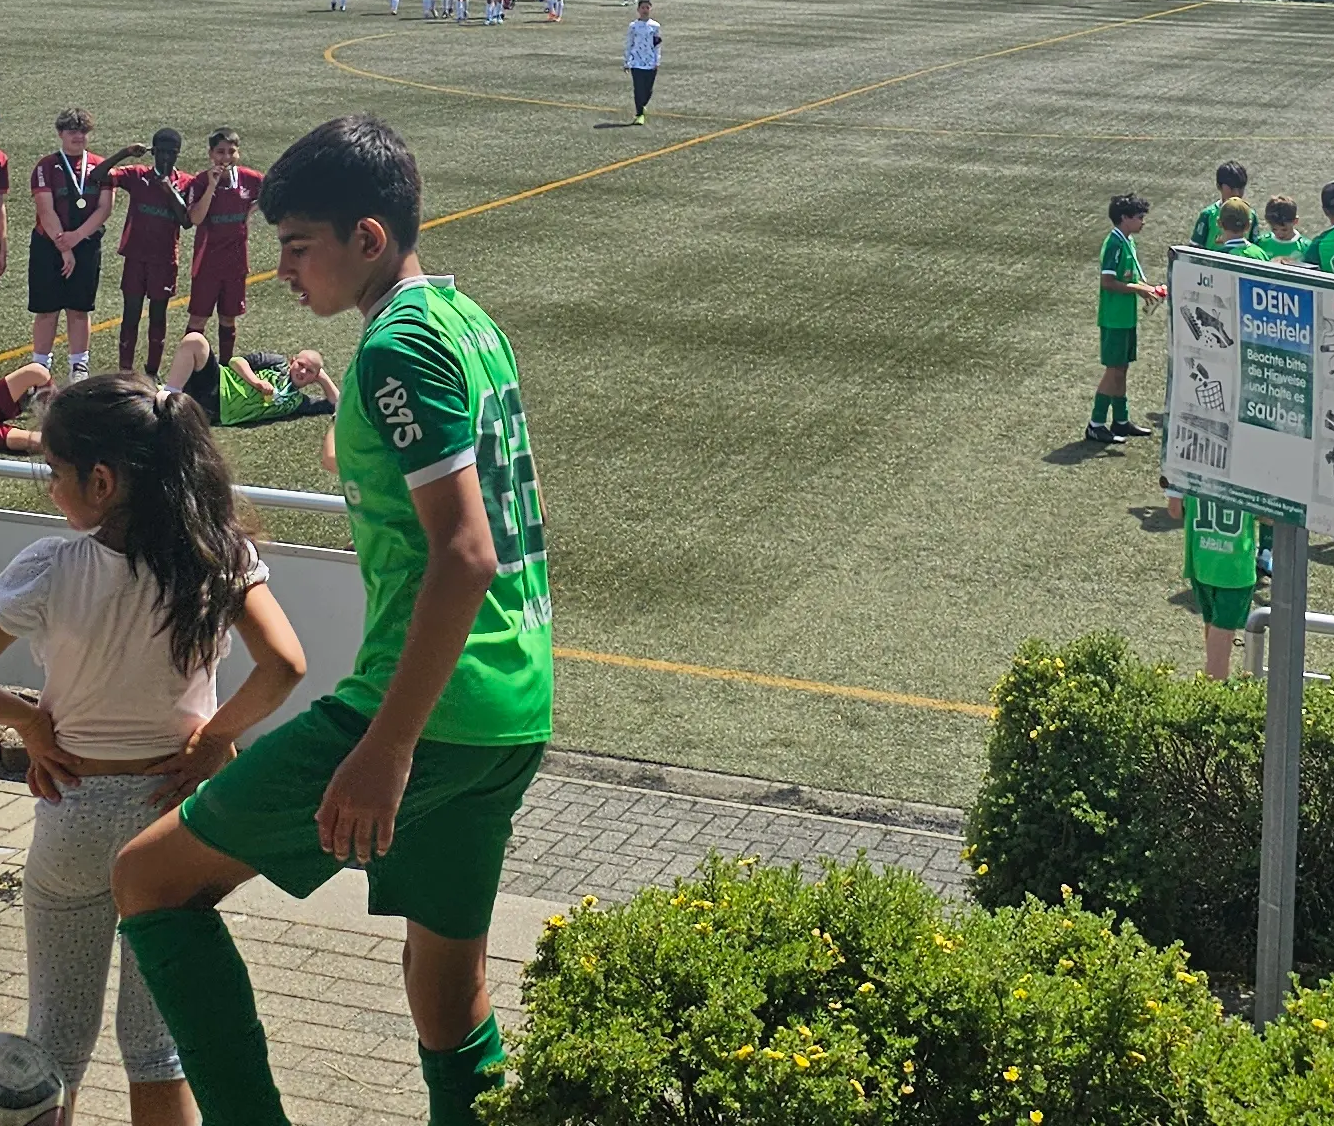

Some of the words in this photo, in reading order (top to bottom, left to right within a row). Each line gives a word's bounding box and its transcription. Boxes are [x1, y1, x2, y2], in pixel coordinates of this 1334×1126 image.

[1196, 273, 1214, 288] Ja!
[1252, 287, 1300, 318] DEIN
[1242, 314, 1311, 346] Spielfeld
[1246, 349, 1285, 369] Beachte
[1286, 356, 1308, 373] bitte
[1247, 366, 1263, 379] die
[1248, 382, 1267, 396] und
[1293, 392, 1306, 403] es
[375, 376, 424, 449] 1895
[1246, 399, 1306, 428] sauber
